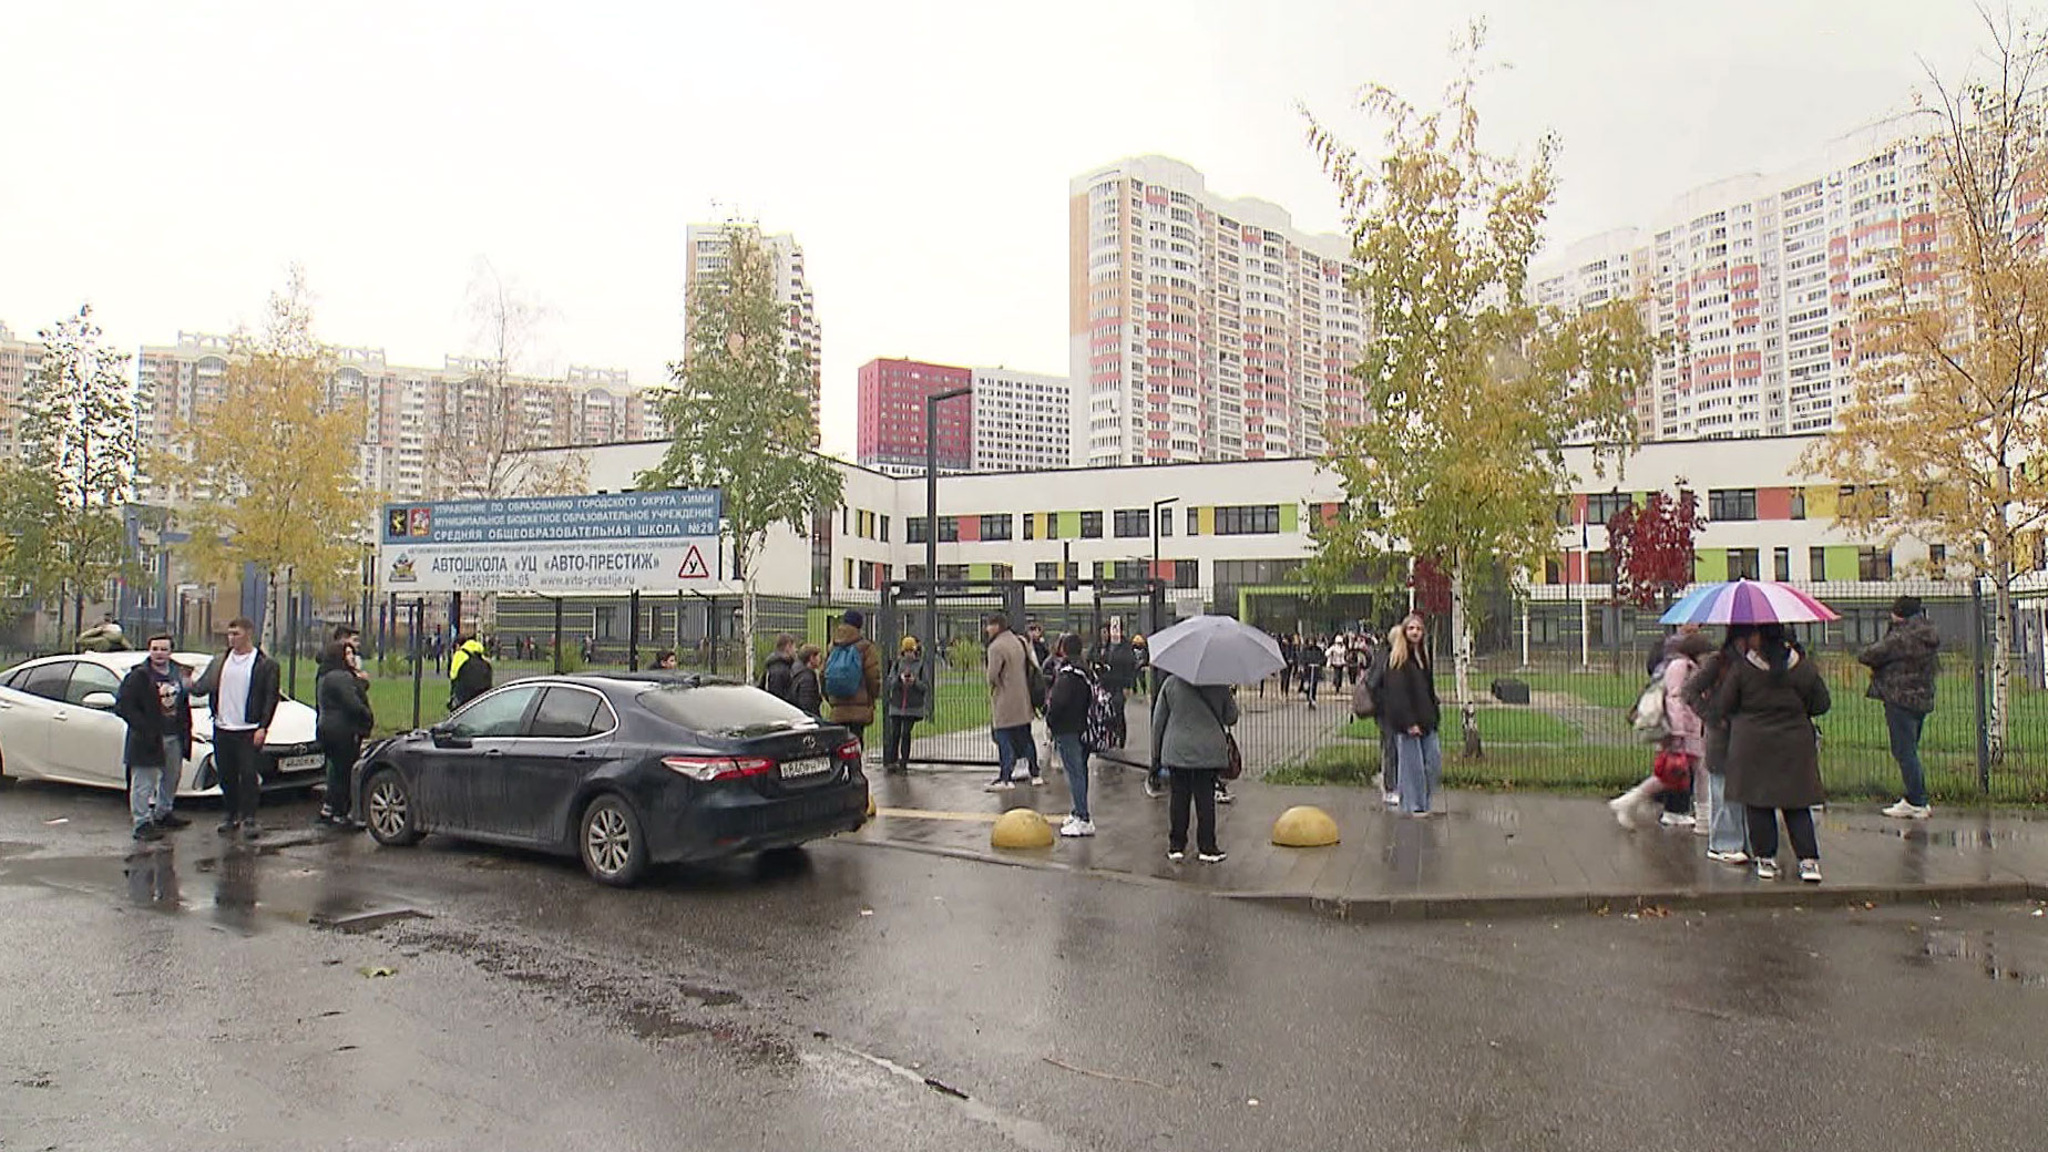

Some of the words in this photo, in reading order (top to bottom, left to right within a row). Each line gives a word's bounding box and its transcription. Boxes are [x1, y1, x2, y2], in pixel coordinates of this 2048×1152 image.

[491, 502, 504, 512] ПО
[508, 500, 573, 511] ОБРАЗОВАНИЮ
[578, 497, 636, 509] ГОРОДСКОГО
[642, 496, 677, 506] ОКРУГА
[682, 495, 714, 504] ХИМКИ
[507, 513, 560, 524] БЮДЖЕТНОЕ
[563, 510, 648, 522] ОБРАЗОВАТЕЛЬНОЕ
[652, 508, 712, 519] УЧРЕЖДЕНИЕ
[434, 529, 482, 541] СРЕДНЯЯ
[488, 525, 631, 540] ОБЩЕОБРАЗОВАТЕЛЬНАЯ
[638, 524, 681, 535] ШКОЛА
[432, 557, 507, 572] АВТОШКОЛА
[515, 555, 537, 574] «УЦ
[544, 553, 660, 571] «АВТО-ПРЕСТИЖ»
[541, 573, 636, 587] www.avto-prestije.ru
